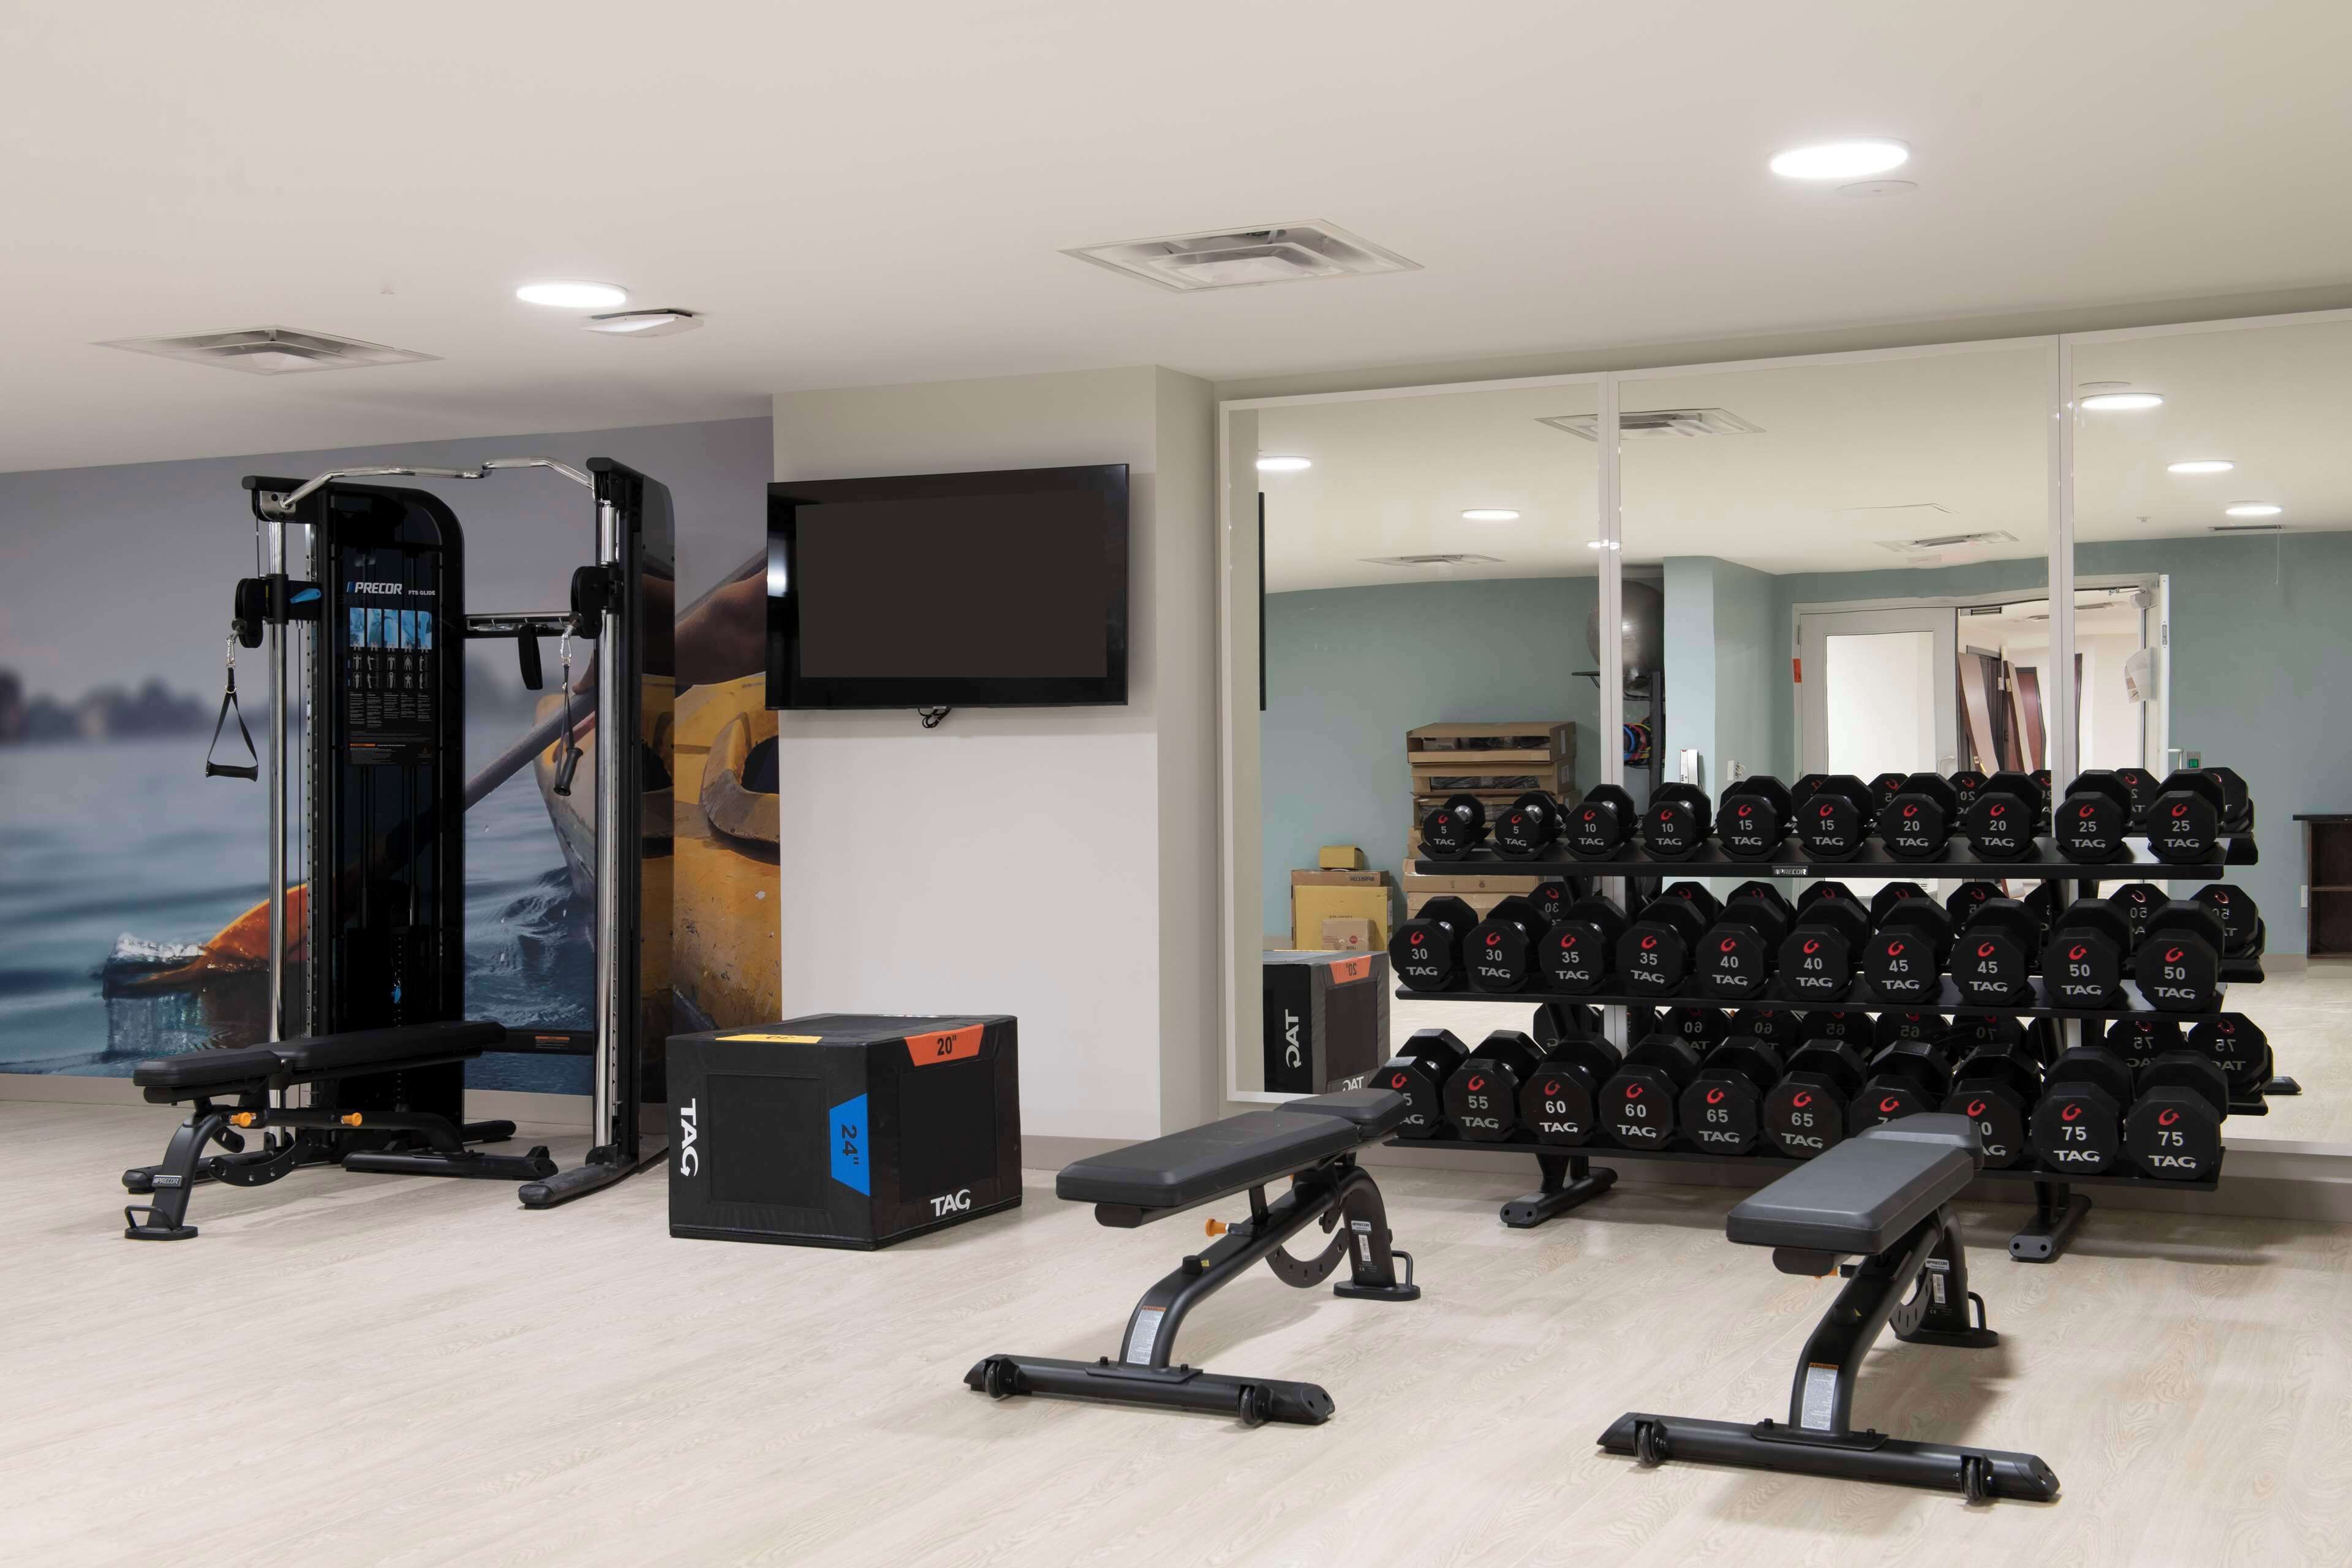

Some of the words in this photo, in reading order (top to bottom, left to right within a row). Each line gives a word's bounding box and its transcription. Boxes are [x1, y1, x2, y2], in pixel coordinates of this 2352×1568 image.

[354, 581, 402, 595] PRECOR
[1441, 826, 1447, 834] 5
[1513, 826, 1519, 834] 5
[1585, 823, 1597, 832] 10
[1661, 823, 1674, 832] 10
[1739, 820, 1753, 831] 15
[1820, 820, 1834, 831] 15
[1903, 820, 1920, 831] 20
[1989, 820, 2007, 831] 20
[2079, 821, 2097, 832] 25
[2172, 820, 2190, 832] 25
[1504, 837, 1527, 847] TAG
[1578, 837, 1604, 846] TAG
[1731, 836, 1762, 846] TAG
[1812, 837, 1844, 846] TAG
[1896, 837, 1929, 847] TAG
[1981, 837, 2015, 848] TAG
[2071, 839, 2106, 848] TAG
[2163, 839, 2199, 848] TAG
[1411, 948, 1428, 960] 30
[1486, 949, 1502, 961] 30
[1561, 951, 1579, 963] 35
[1640, 952, 1658, 965] 35
[1720, 956, 1738, 968] 40
[1804, 957, 1823, 970] 40
[1889, 959, 1909, 972] 45
[1977, 961, 1998, 974] 45
[1406, 967, 1438, 976] TAG
[1477, 967, 1511, 979] TAG
[1555, 970, 1589, 980] TAG
[2069, 964, 2090, 977] 50
[2164, 966, 2185, 980] 50
[1630, 970, 1665, 984] TAG
[1712, 974, 1748, 986] TAG
[1796, 977, 1833, 988] TAG
[1881, 979, 1920, 990] TAG
[1969, 981, 2008, 992] TAG
[2061, 985, 2102, 995] TAG
[2154, 987, 2196, 1000] TAG
[1403, 1093, 1412, 1106] 5
[1468, 1095, 1488, 1109] 55
[1545, 1100, 1566, 1114] 60
[1625, 1103, 1646, 1118] 60
[1400, 1114, 1425, 1125] AG
[1706, 1109, 1728, 1123] 65
[1791, 1112, 1814, 1128] 65
[1461, 1116, 1499, 1129] TAG
[1539, 1122, 1578, 1133] TAG
[1975, 1121, 1992, 1136] 0
[680, 1098, 699, 1177] TAG
[1616, 1125, 1657, 1138] TAG
[1698, 1130, 1740, 1144] TAG
[2061, 1126, 2087, 1141] 75
[1781, 1133, 1823, 1149] TAG
[2157, 1131, 2184, 1147] 75
[1981, 1145, 2007, 1156] AG
[2053, 1150, 2100, 1163] TAG
[2148, 1155, 2196, 1169] TAG
[930, 1189, 971, 1217] TAG
